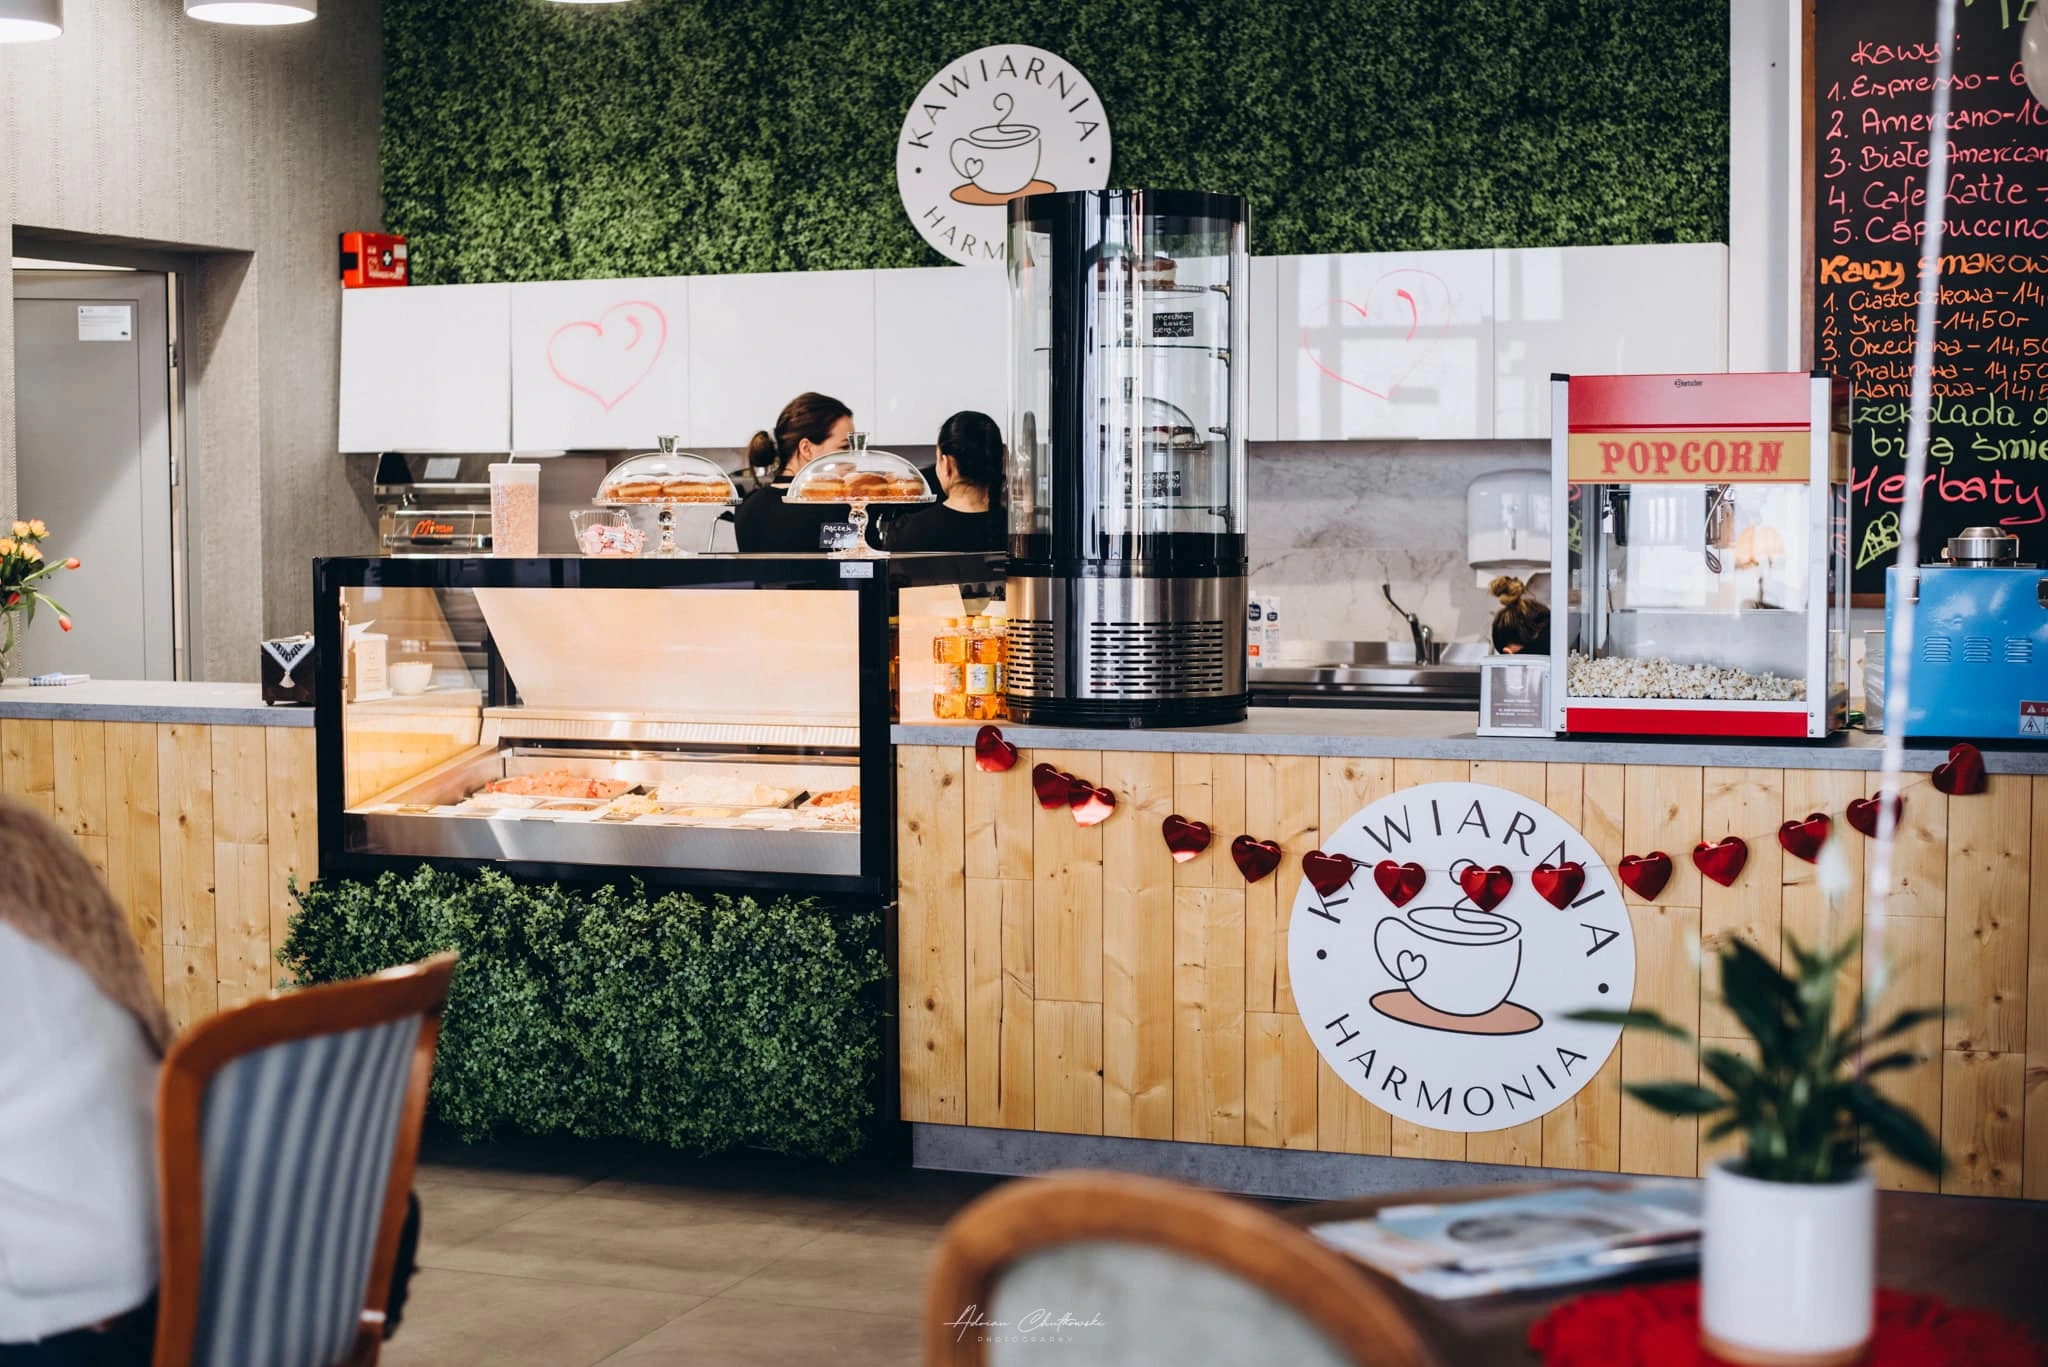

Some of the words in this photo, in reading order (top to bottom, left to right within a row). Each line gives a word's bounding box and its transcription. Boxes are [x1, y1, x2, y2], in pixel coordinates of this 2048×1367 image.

[908, 55, 1100, 149] KAWIARNIA
[923, 205, 1005, 261] HARM
[1820, 255, 1905, 291] Kawy
[1849, 334, 1963, 357] Orzechwa
[1849, 360, 1959, 381] Pralinwa
[1598, 439, 1785, 475] POPCORN
[1851, 465, 2047, 526] Herbaty
[1325, 1013, 1588, 1117] HARMONIA
